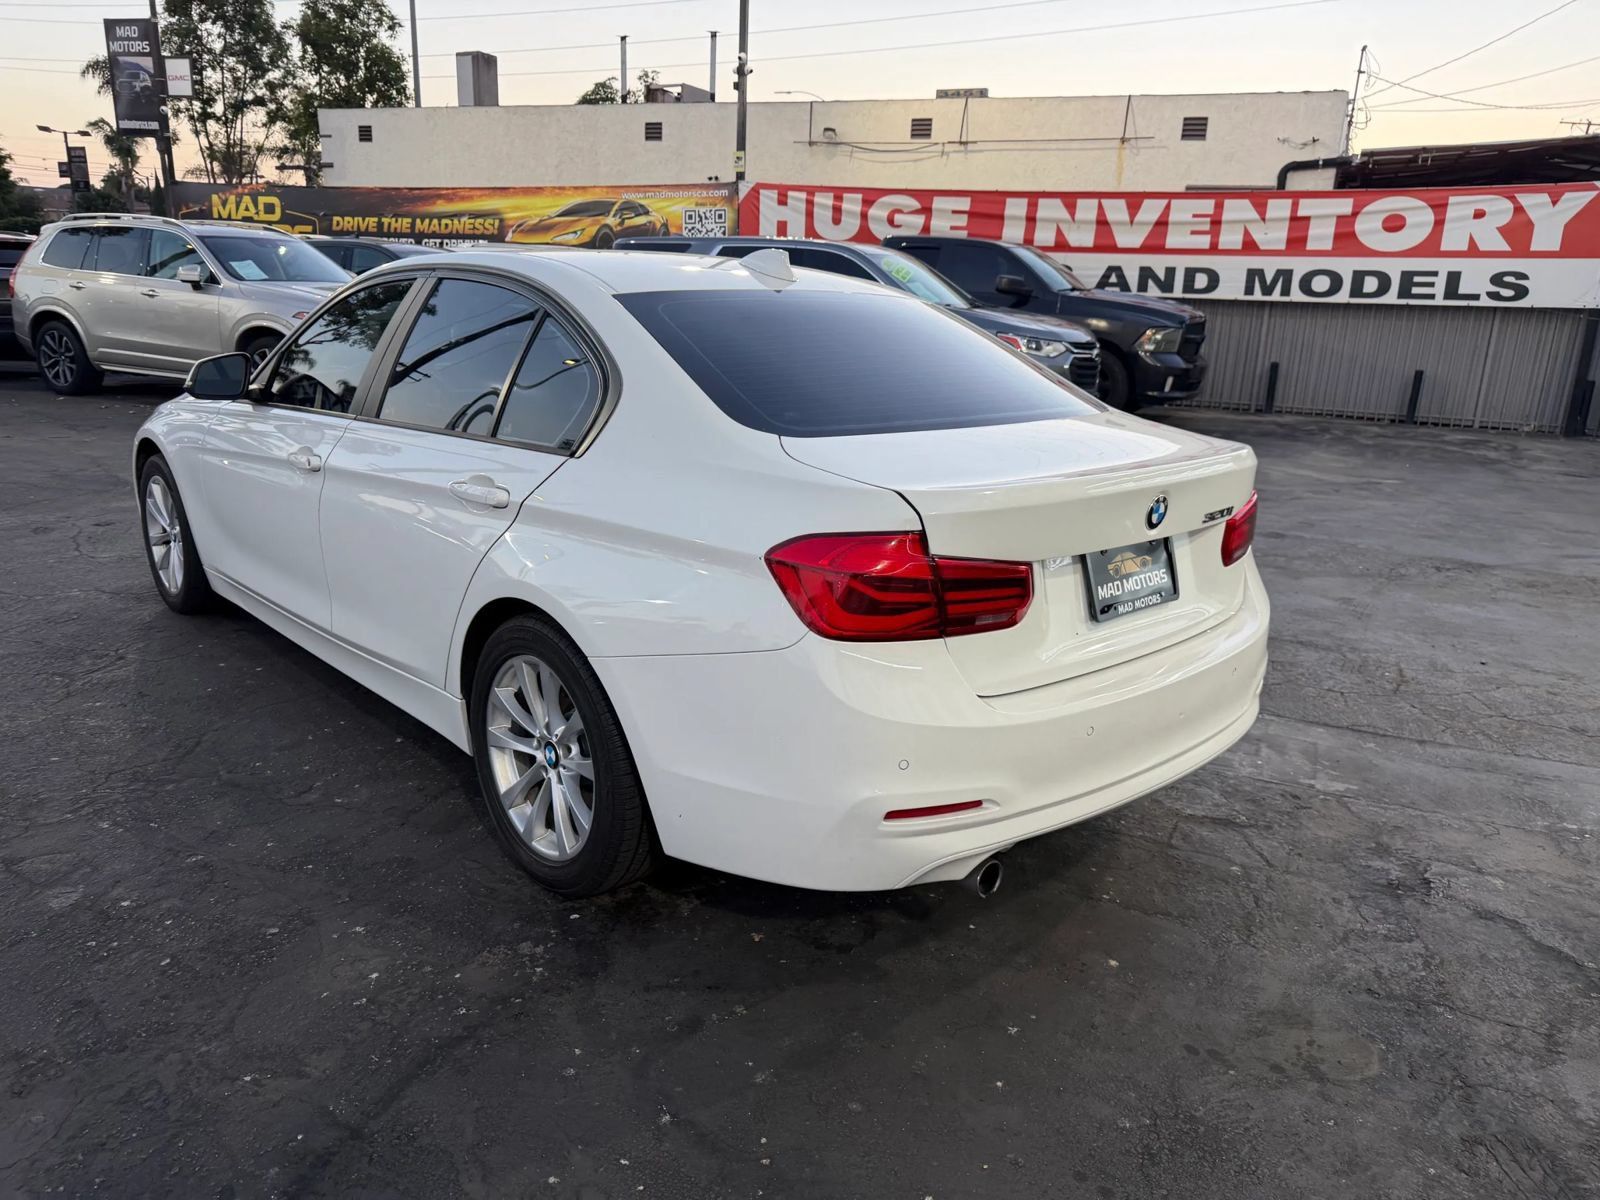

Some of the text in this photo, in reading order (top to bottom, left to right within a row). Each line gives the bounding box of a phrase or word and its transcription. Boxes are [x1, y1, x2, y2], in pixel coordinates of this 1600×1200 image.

[115, 26, 138, 37] MAD
[109, 41, 150, 52] MOTORS
[621, 189, 728, 199] www.madmotorsca.com
[211, 194, 282, 221] MAD
[332, 216, 378, 232] DRIVE
[381, 217, 412, 233] THE
[415, 218, 499, 235] MADNESS!
[759, 189, 1599, 252] HUGE INVENTORY
[422, 239, 442, 248] GET
[1094, 265, 1531, 302] AND MODELS
[1097, 569, 1168, 600] MAD MOTORS
[1118, 594, 1161, 615] MAD MOTORS
